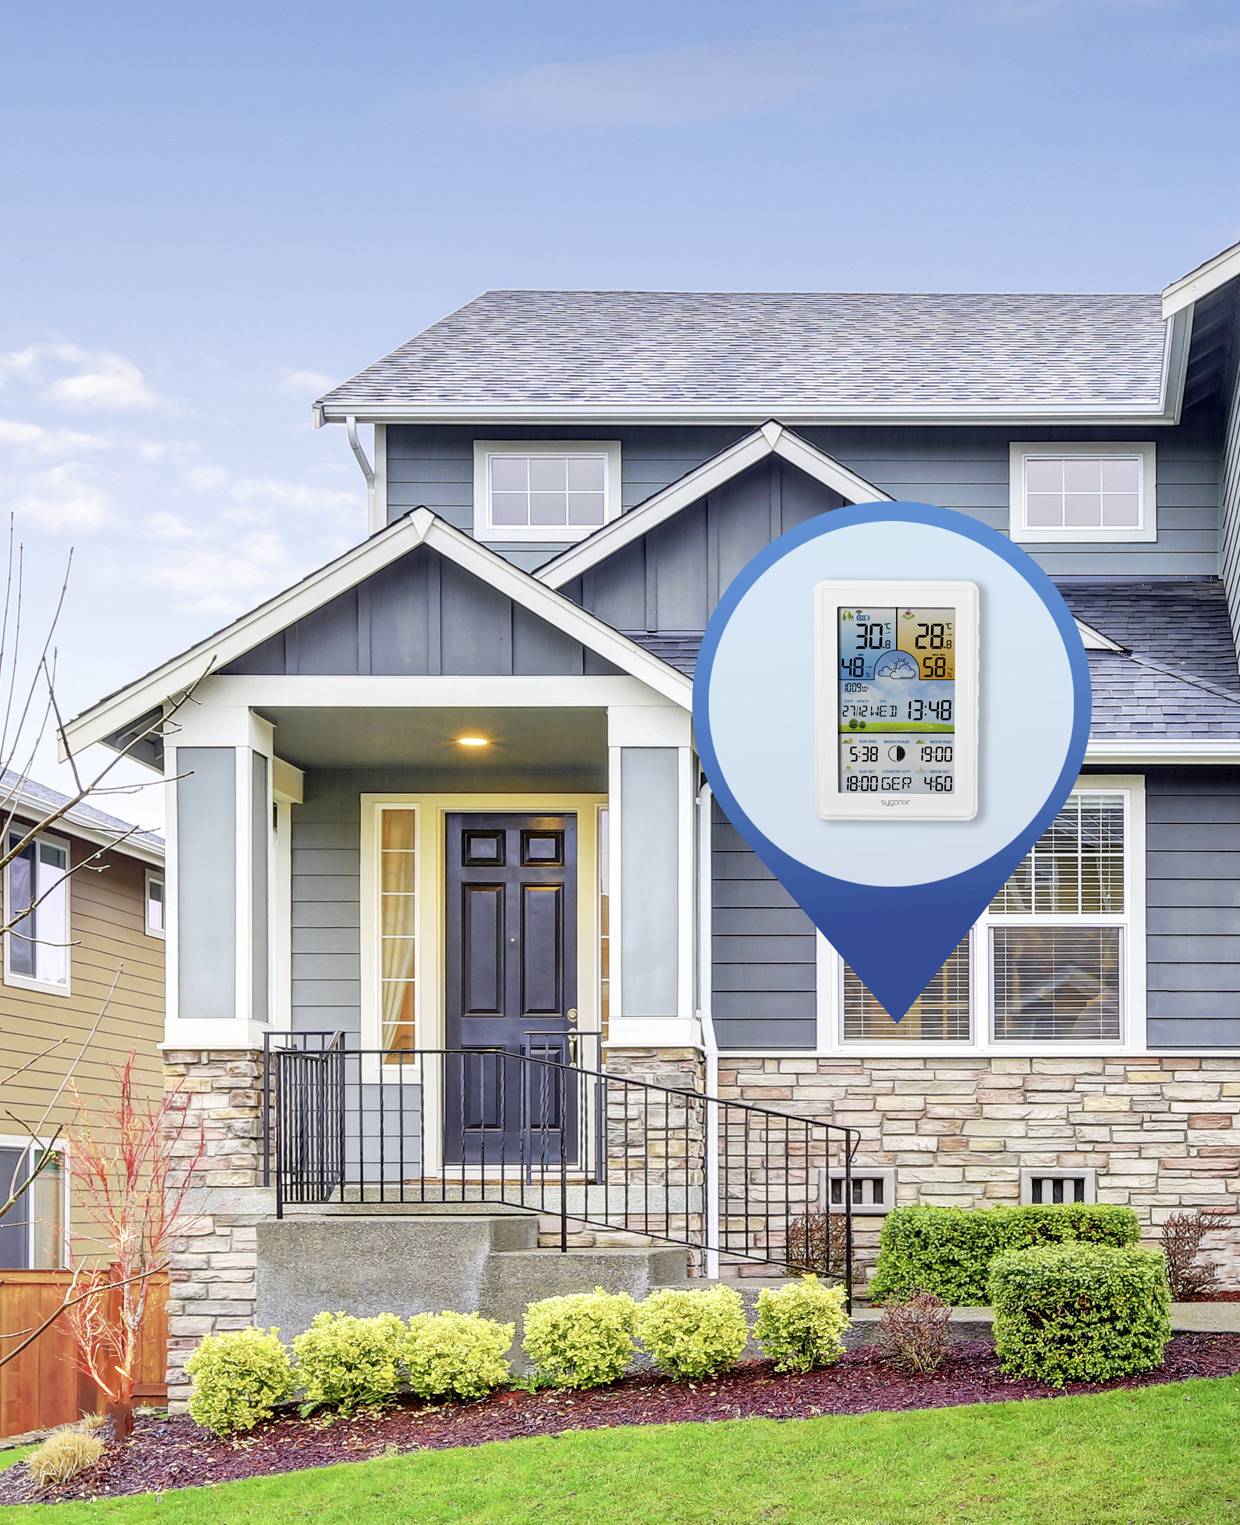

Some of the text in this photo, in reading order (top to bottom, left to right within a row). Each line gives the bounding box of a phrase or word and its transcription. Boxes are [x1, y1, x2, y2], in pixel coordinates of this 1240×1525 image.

[841, 656, 865, 678] 48
[922, 656, 946, 678] 58
[844, 682, 862, 693] 1009
[908, 699, 952, 721] 13:48
[849, 746, 879, 762] 5:38
[920, 746, 953, 762] 19:00
[846, 775, 879, 792] 18:00
[881, 776, 912, 791] GER
[924, 775, 953, 792] 4:60
